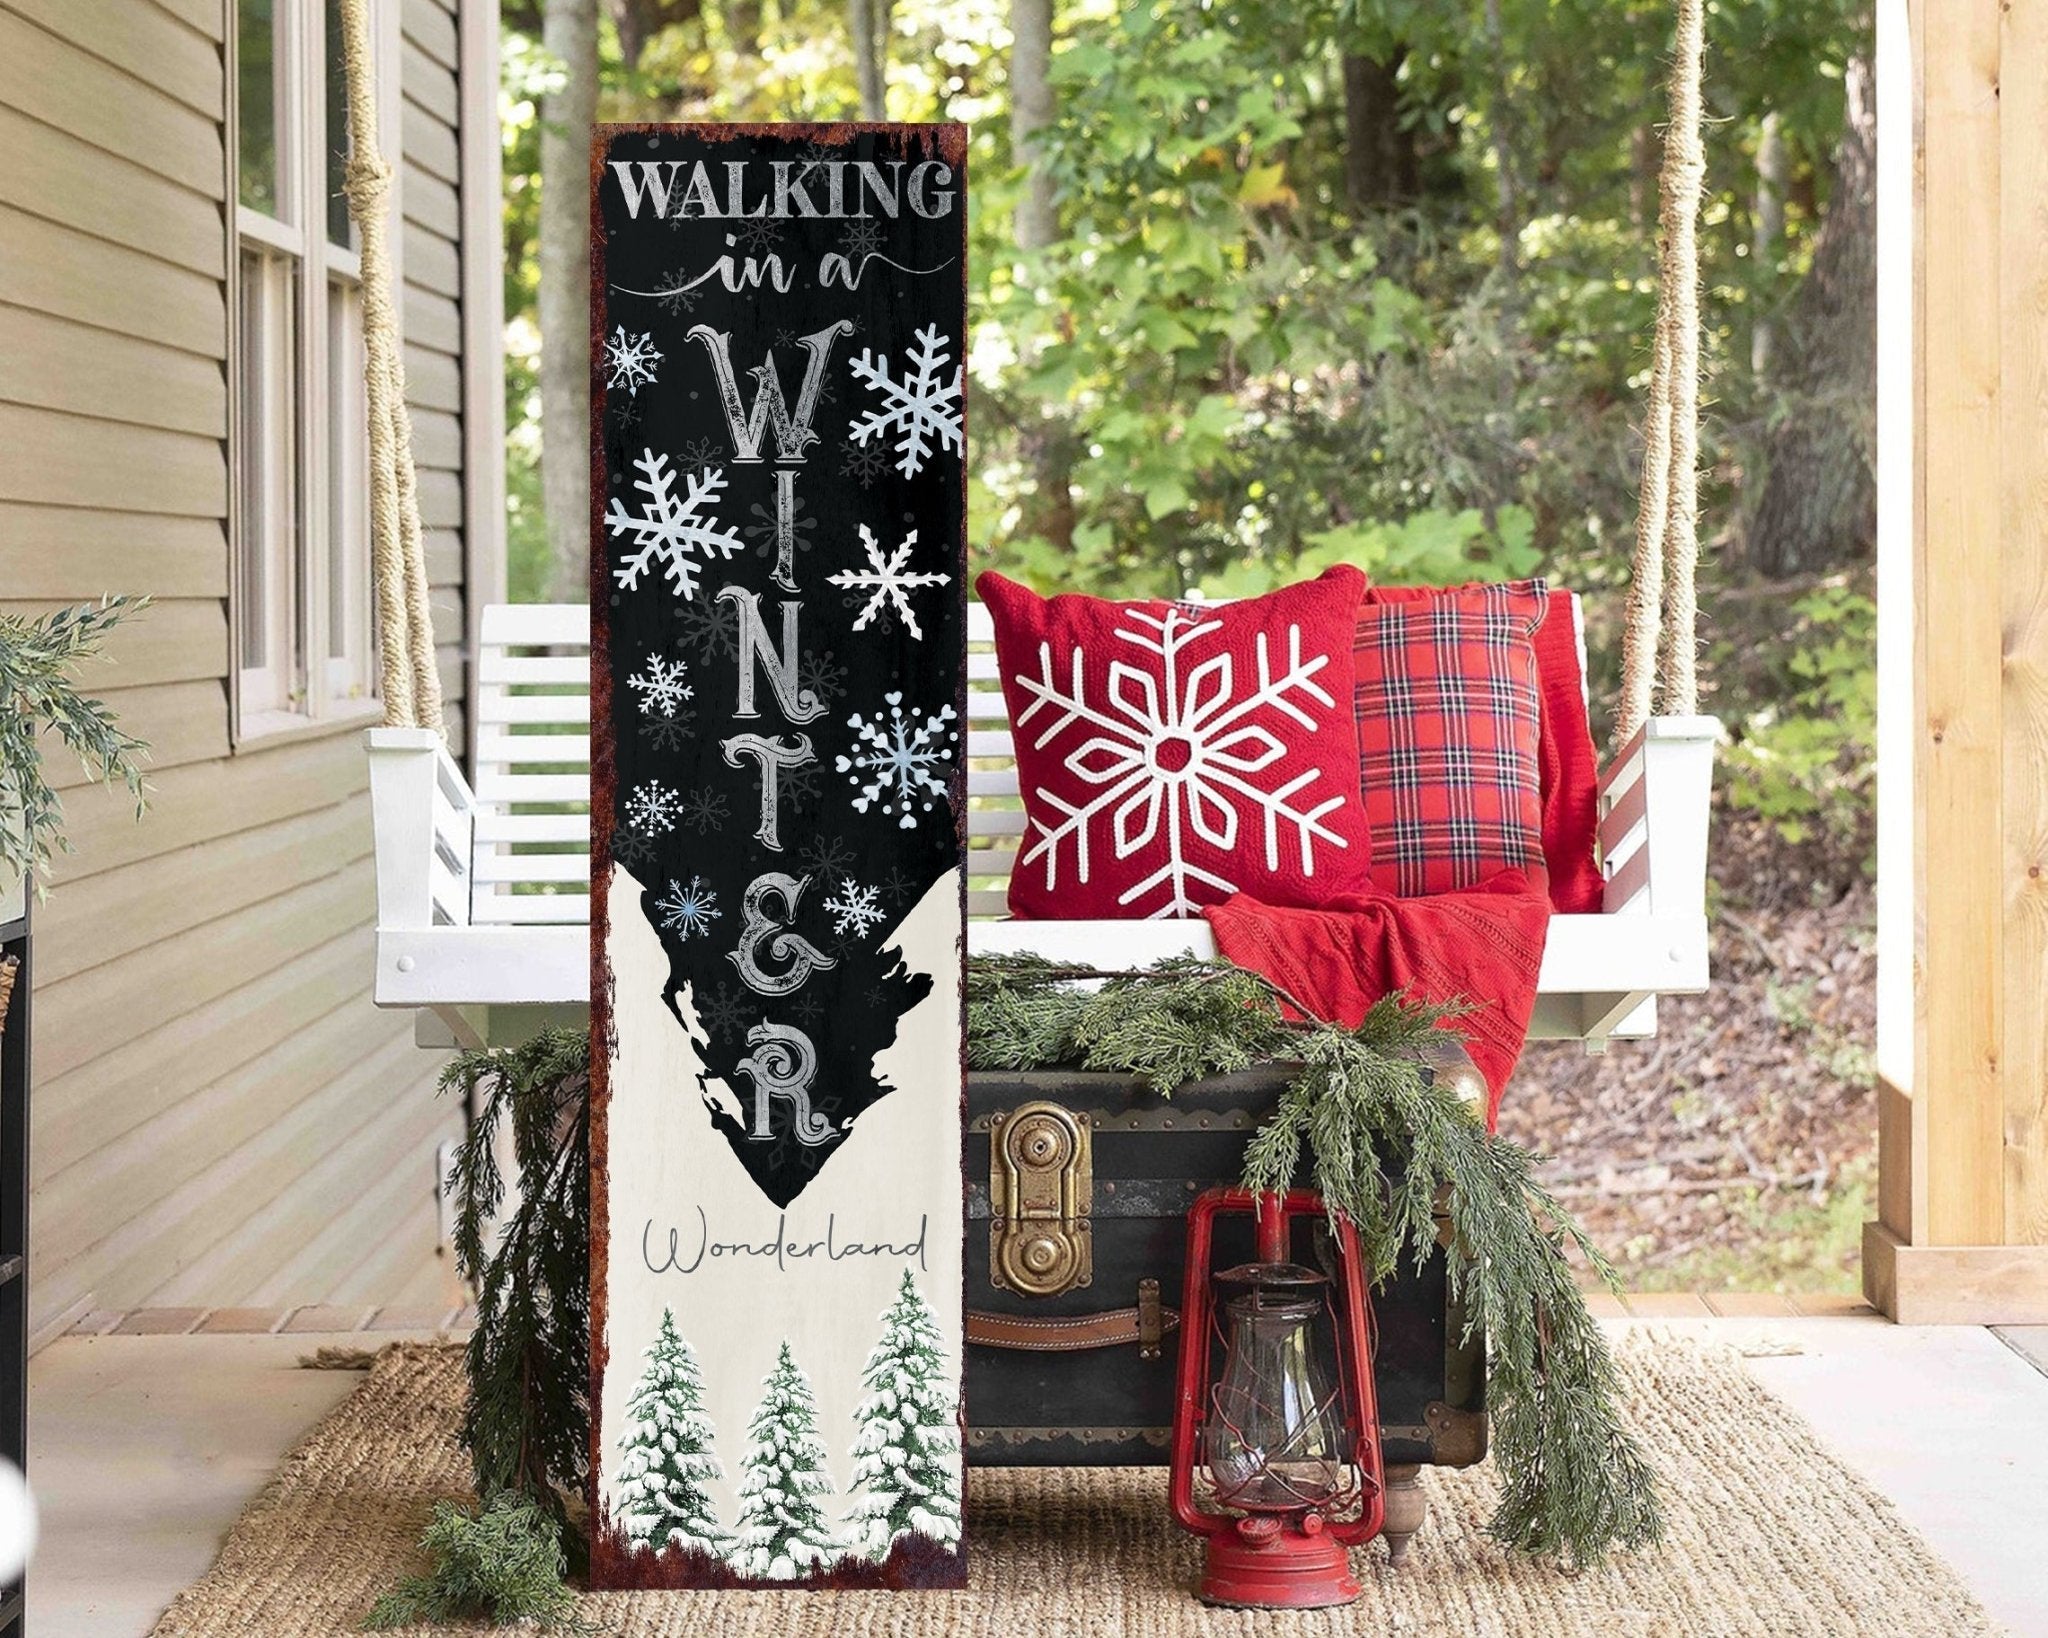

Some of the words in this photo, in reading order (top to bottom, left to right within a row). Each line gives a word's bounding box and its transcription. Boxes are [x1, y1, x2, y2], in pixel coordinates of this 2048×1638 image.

[607, 160, 957, 219] WALKING
[684, 319, 856, 1146] WINTER
[642, 1205, 928, 1274] Wonderland
